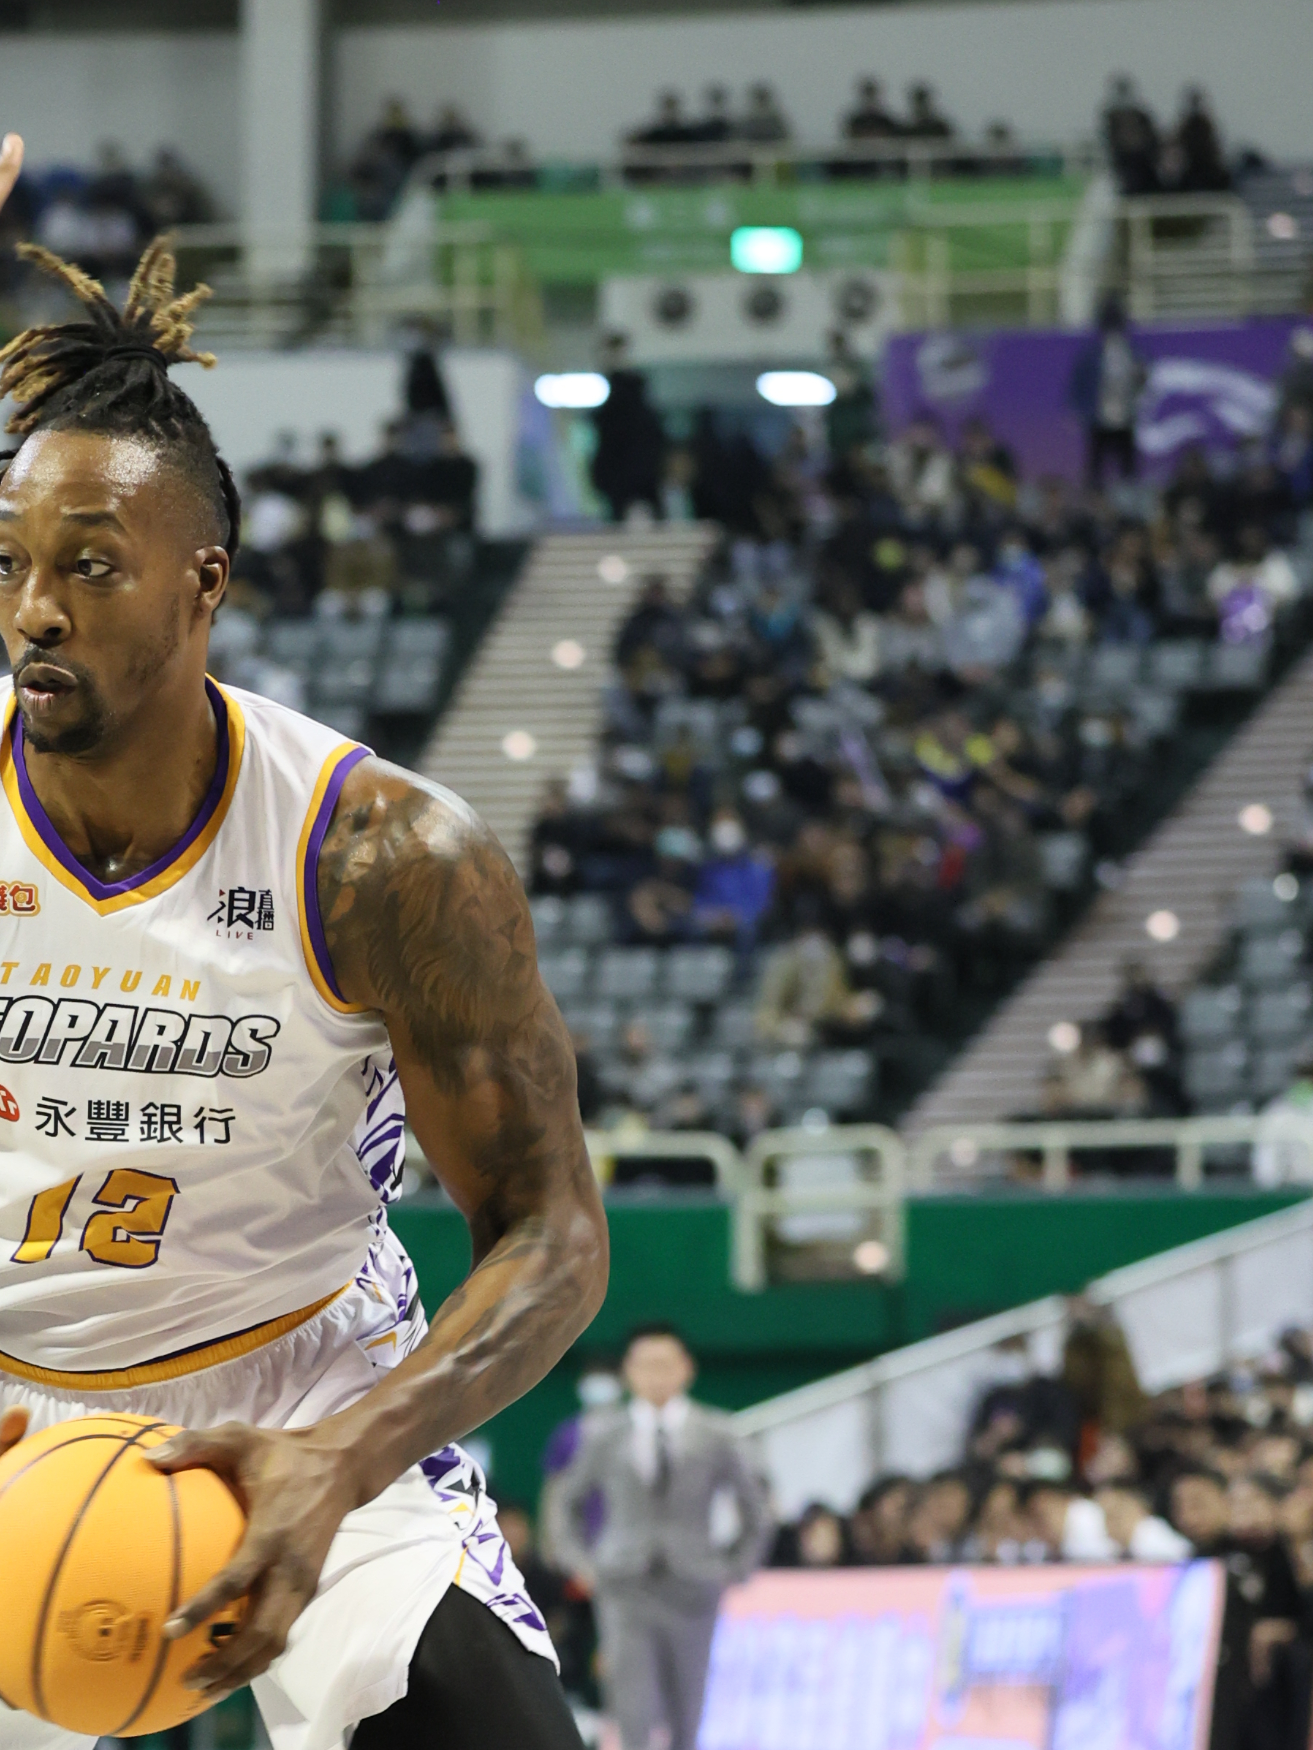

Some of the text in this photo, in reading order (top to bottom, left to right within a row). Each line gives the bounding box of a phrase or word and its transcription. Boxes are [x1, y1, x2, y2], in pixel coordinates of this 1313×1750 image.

[215, 929, 254, 941] LIVE
[0, 961, 202, 1002] TAOYUAN
[34, 1096, 236, 1144] 永豐銀行
[10, 1168, 181, 1269] 12
